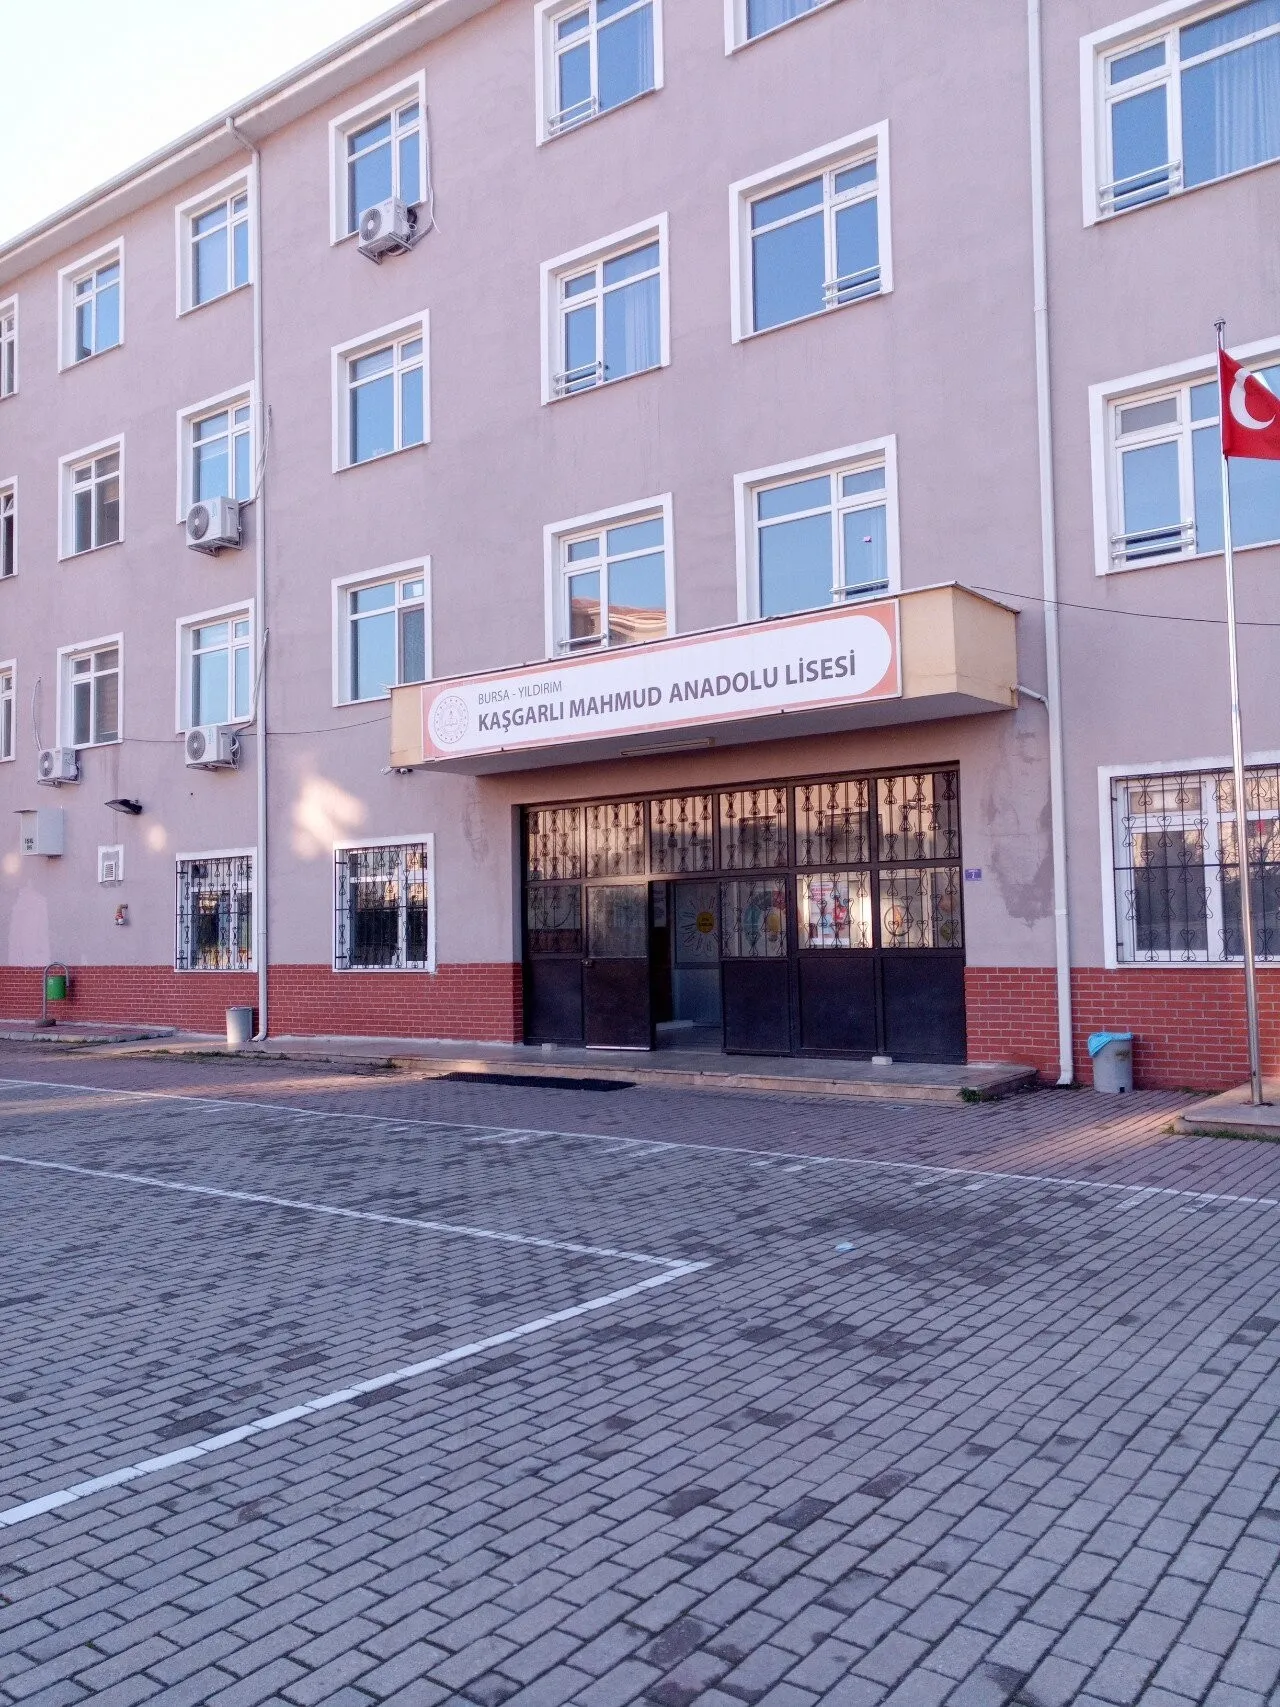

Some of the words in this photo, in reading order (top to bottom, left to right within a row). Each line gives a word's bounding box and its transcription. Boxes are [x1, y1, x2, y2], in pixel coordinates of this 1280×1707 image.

[478, 701, 564, 733] KAŞGARLI
[569, 686, 662, 719] MAHMUD
[668, 666, 778, 704] ANADOLU
[785, 649, 855, 685] LİSESİ
[478, 689, 510, 705] BURSA
[518, 681, 562, 698] YILDIRIM
